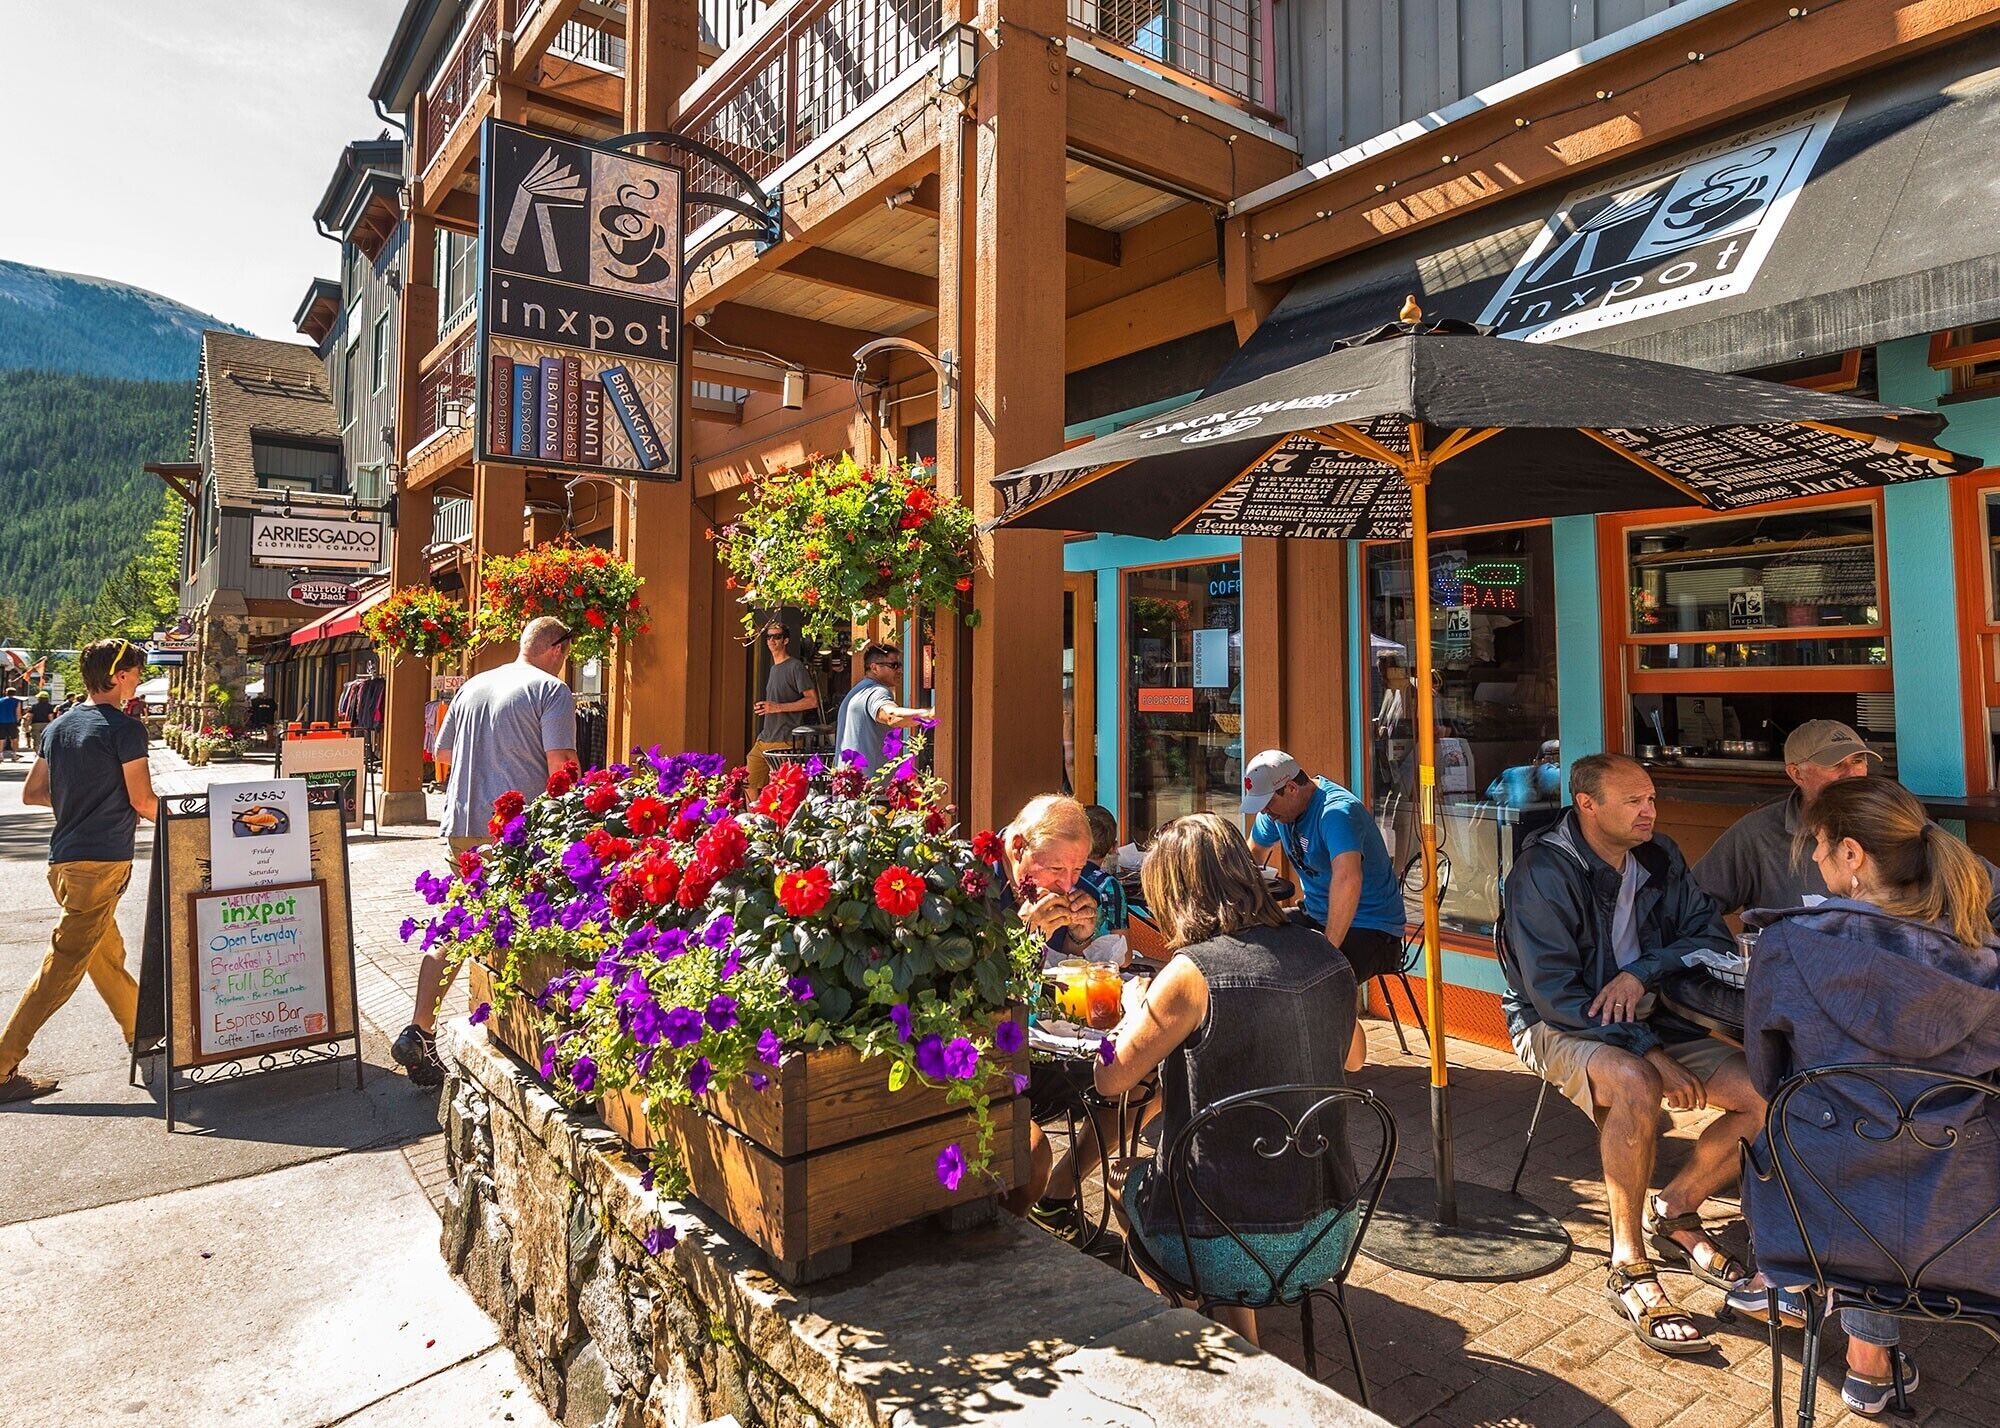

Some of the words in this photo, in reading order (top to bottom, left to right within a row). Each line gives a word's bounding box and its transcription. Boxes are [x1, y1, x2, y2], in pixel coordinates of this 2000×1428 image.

[1760, 110, 1826, 136] words
[1497, 240, 1738, 327] inxpot
[1598, 284, 1731, 321] colorado
[501, 279, 670, 351] inxpot
[568, 362, 578, 387] BAR
[499, 368, 508, 406] GOODS
[521, 375, 533, 451] BOOKSTORE
[546, 367, 558, 451] LIBATIONS
[611, 373, 662, 461] BREAKFAST
[498, 410, 508, 444] BAKED
[567, 392, 578, 457] ESPRESSO
[585, 390, 599, 456] LUNCH
[1739, 431, 1797, 454] 1866
[1268, 453, 1299, 473] 7
[1351, 484, 1378, 504] 1866
[1269, 509, 1304, 517] DANIEL
[258, 525, 376, 546] ARRIESGADO
[1196, 519, 1283, 532] Tennessee
[258, 541, 312, 549] CLOTHING
[1463, 585, 1516, 608] BAR
[1142, 695, 1189, 704] BOOKSTORE
[287, 749, 360, 760] ARRIESGADO
[234, 790, 286, 802] SUSHI
[251, 847, 275, 856] Friday
[256, 857, 270, 865] and
[248, 867, 279, 877] Saturday
[221, 895, 296, 924] inxpot
[227, 891, 271, 908] WELCOME
[210, 935, 247, 953] Open
[250, 925, 298, 945] Everyday
[277, 944, 306, 966] Lunch
[227, 972, 252, 993] Full
[262, 968, 290, 988] Bar
[214, 1009, 275, 1033] Espresso
[278, 1001, 304, 1022] Bar
[218, 1033, 243, 1047] Coffee
[250, 1029, 265, 1042] Tea
